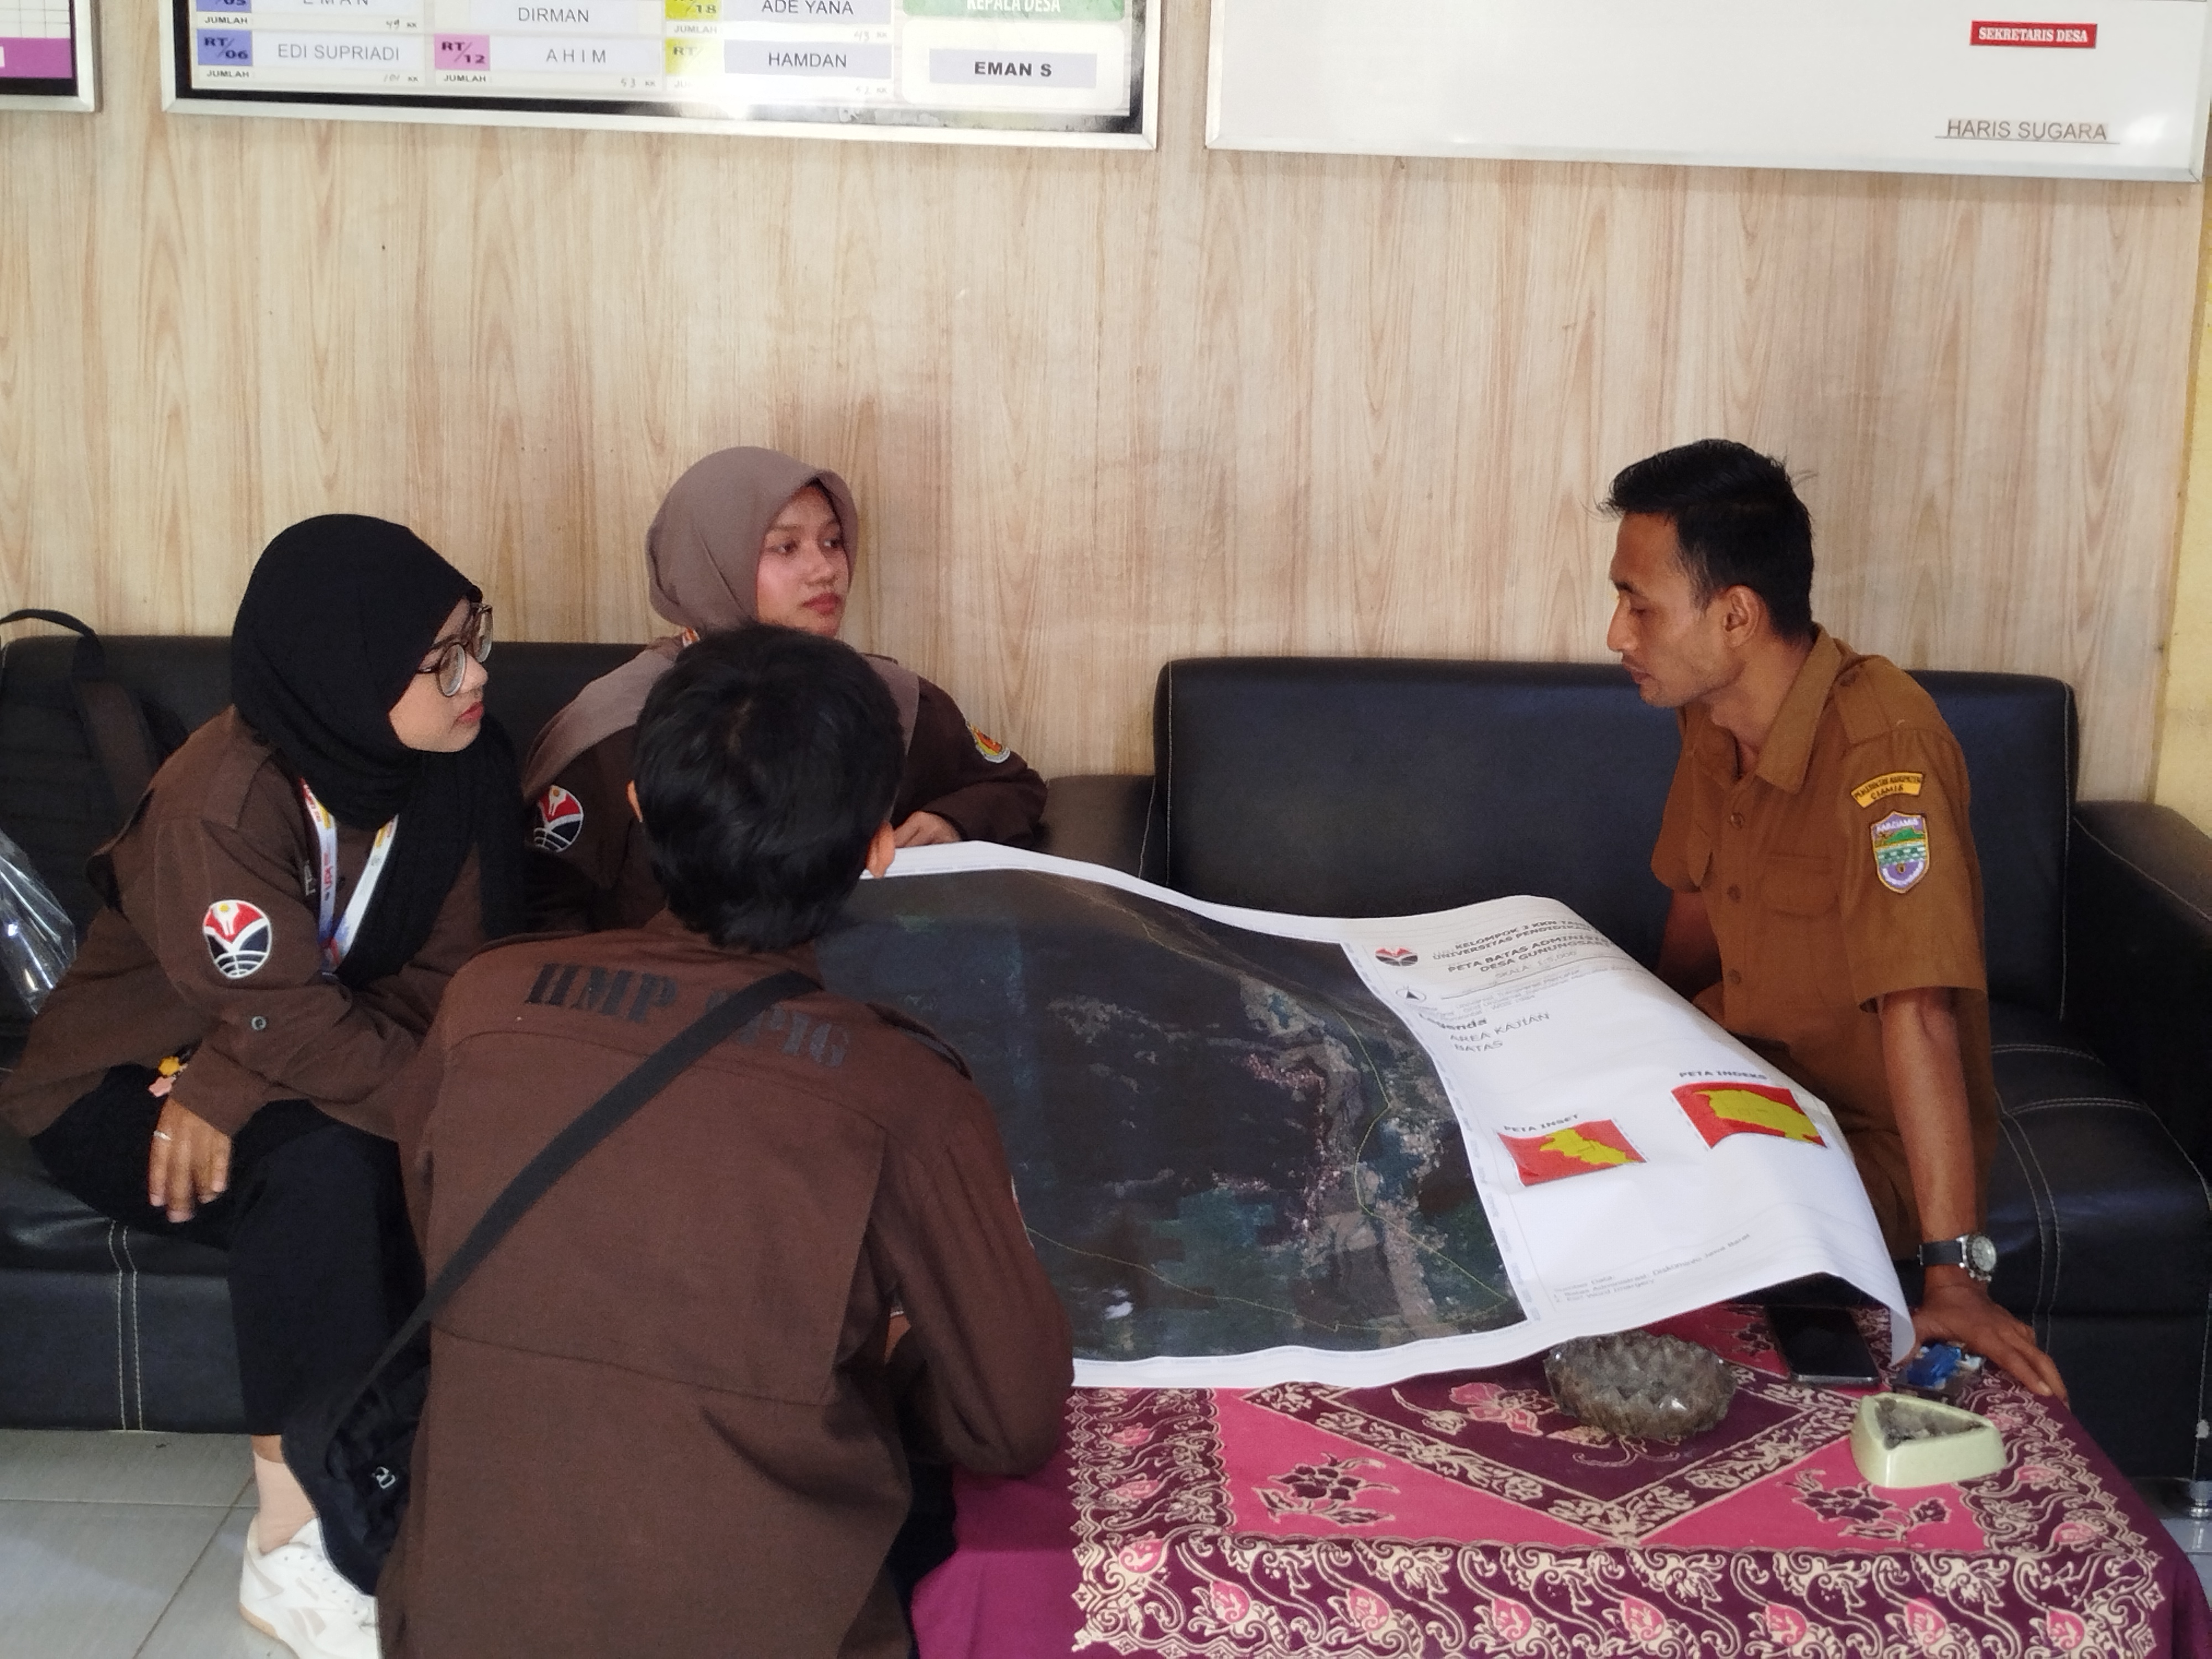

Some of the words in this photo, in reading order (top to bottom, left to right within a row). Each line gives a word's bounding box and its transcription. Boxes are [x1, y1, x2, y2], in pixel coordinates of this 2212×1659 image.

[518, 7, 589, 23] DIRMAN
[761, 0, 799, 14] ADE
[805, 0, 854, 15] YANA
[674, 25, 717, 34] JUMLAH
[1978, 27, 2054, 41] SEKRETARIS
[2056, 29, 2088, 43] DESA
[278, 44, 307, 58] EDI
[314, 45, 399, 61] SUPRIADI
[768, 52, 847, 68] HAMDAN
[974, 61, 1032, 76] EMAN
[1040, 63, 1052, 77] S
[1947, 119, 2011, 138] HARIS
[2017, 121, 2107, 141] SUGARA
[1455, 927, 1517, 950] KELOMPOK
[1432, 936, 1513, 960] UNIVERSITAS
[1448, 962, 1482, 972] PETA
[1485, 946, 1528, 963] BATAS
[1480, 958, 1515, 972] DESA
[525, 963, 679, 1024] HMP
[1450, 1032, 1491, 1041] AREA
[1494, 1011, 1550, 1035] KAJIAN
[1454, 1041, 1503, 1052] BATAS
[1541, 1114, 1578, 1129] INSET
